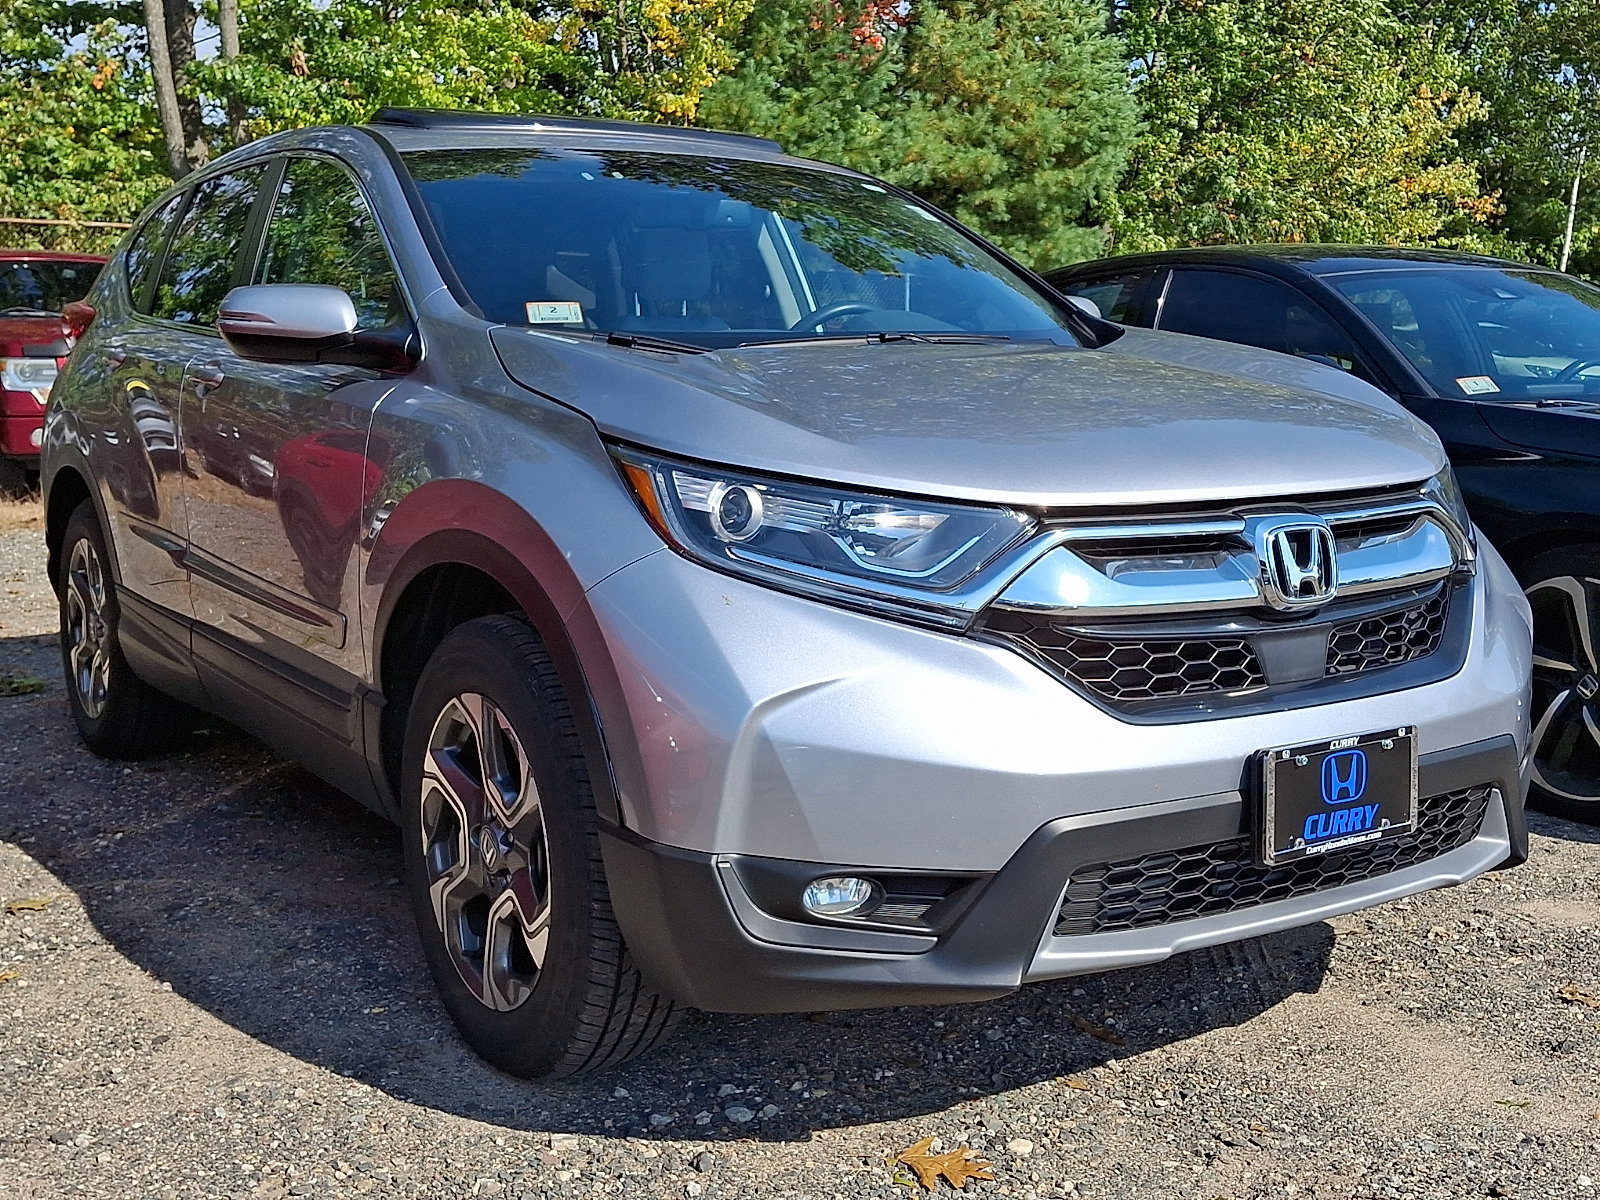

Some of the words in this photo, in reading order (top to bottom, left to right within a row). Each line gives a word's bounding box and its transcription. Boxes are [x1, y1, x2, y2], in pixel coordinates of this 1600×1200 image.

[549, 306, 558, 314] 2
[1330, 736, 1360, 750] CURRY
[1303, 803, 1380, 840] CURRY
